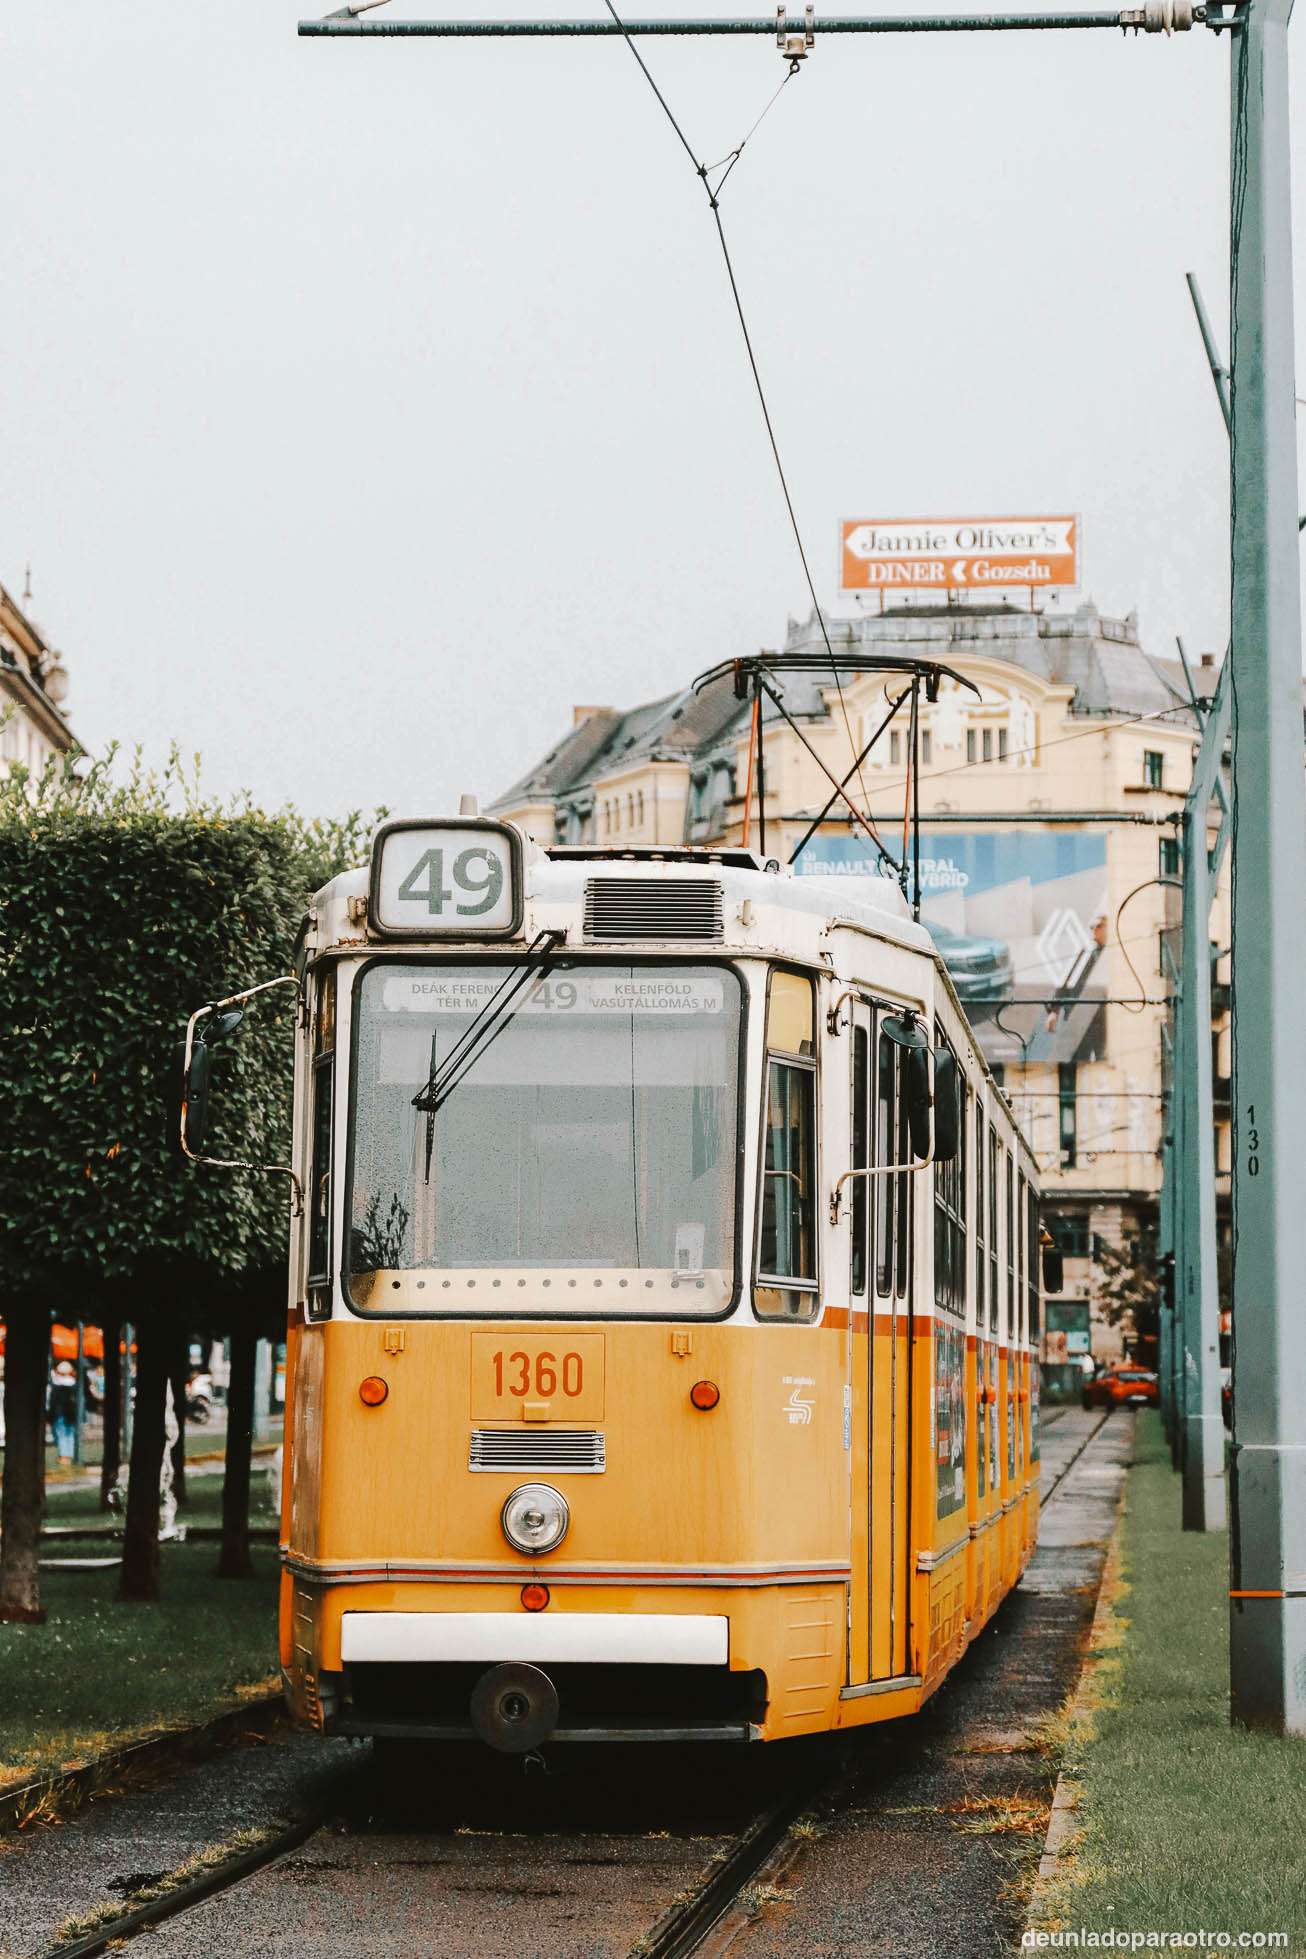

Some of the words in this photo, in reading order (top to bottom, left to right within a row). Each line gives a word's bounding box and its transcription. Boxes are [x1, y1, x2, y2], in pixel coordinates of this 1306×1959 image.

[861, 529, 947, 552] Jamie
[954, 525, 1057, 550] Oliver's
[868, 561, 946, 583] DINER
[971, 560, 1051, 580] Gozsdu
[803, 860, 876, 875] RENAULT
[397, 847, 504, 916] 49
[411, 981, 448, 994] DEÁK
[532, 982, 577, 1009] 49
[614, 982, 692, 995] KELENFÖLD
[437, 995, 462, 1008] TÉR
[465, 998, 478, 1008] M
[591, 996, 699, 1009] VASÚTÁLLOMÁS
[703, 998, 716, 1009] M
[1246, 1104, 1260, 1177] 130
[492, 1351, 583, 1397] 1360
